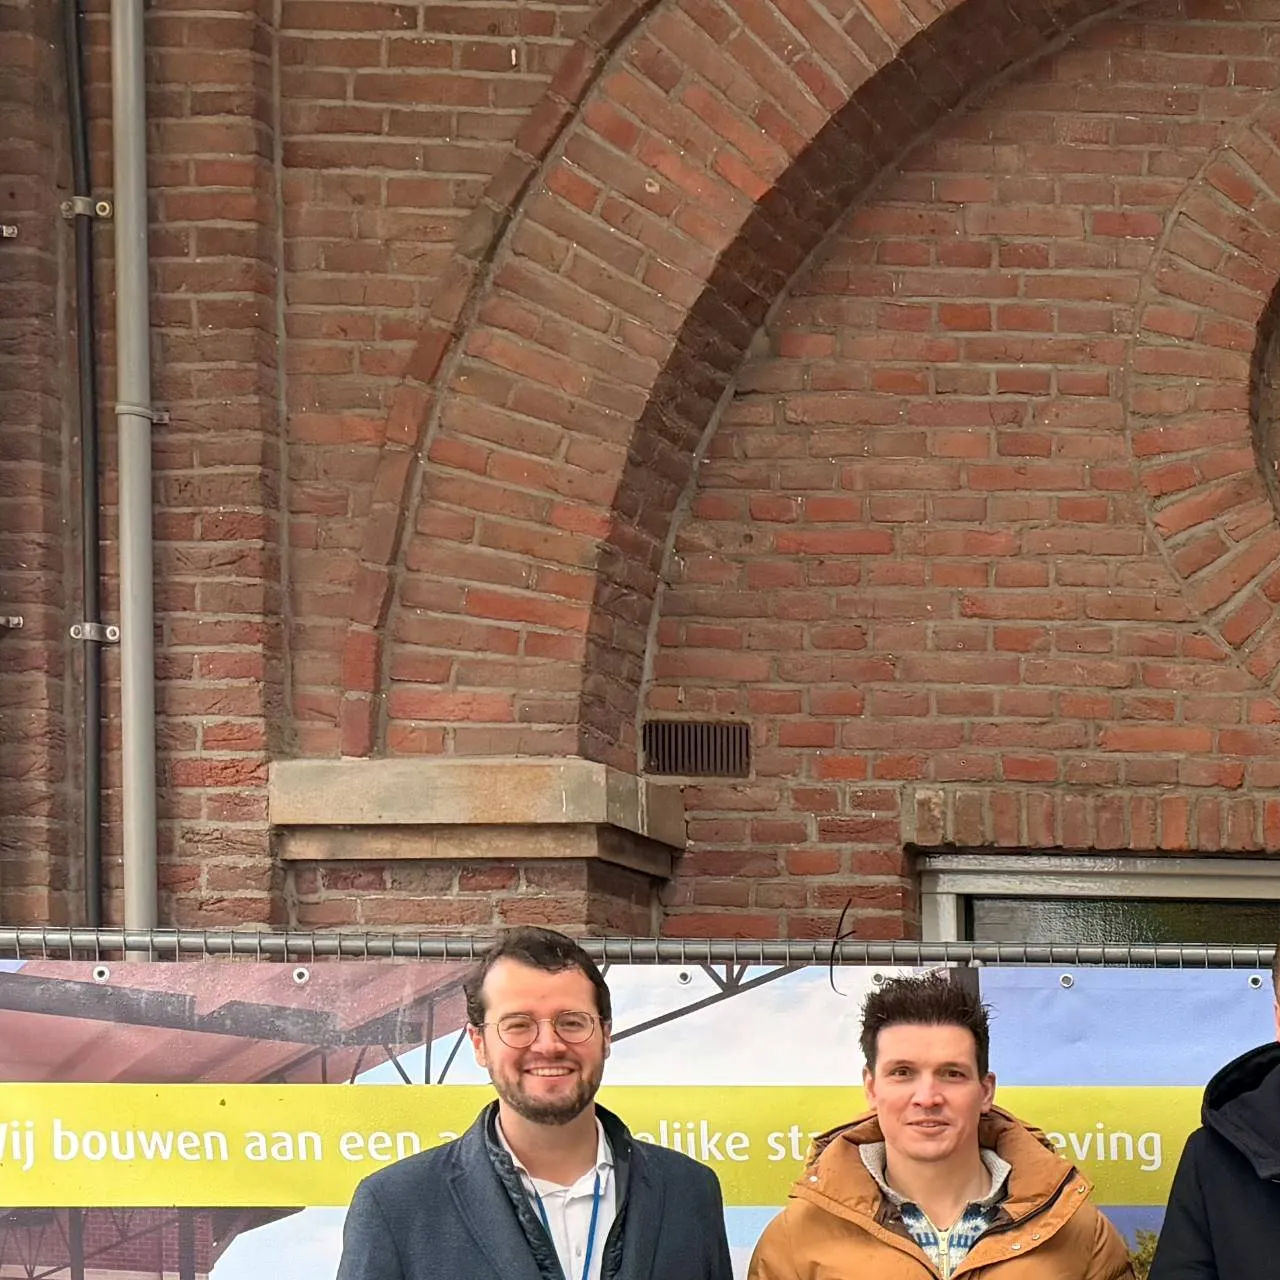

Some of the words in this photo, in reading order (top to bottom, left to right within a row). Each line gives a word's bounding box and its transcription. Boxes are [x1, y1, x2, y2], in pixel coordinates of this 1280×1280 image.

[53, 1118, 229, 1161] bouwen
[244, 1130, 322, 1161] aan
[339, 1130, 422, 1162] een
